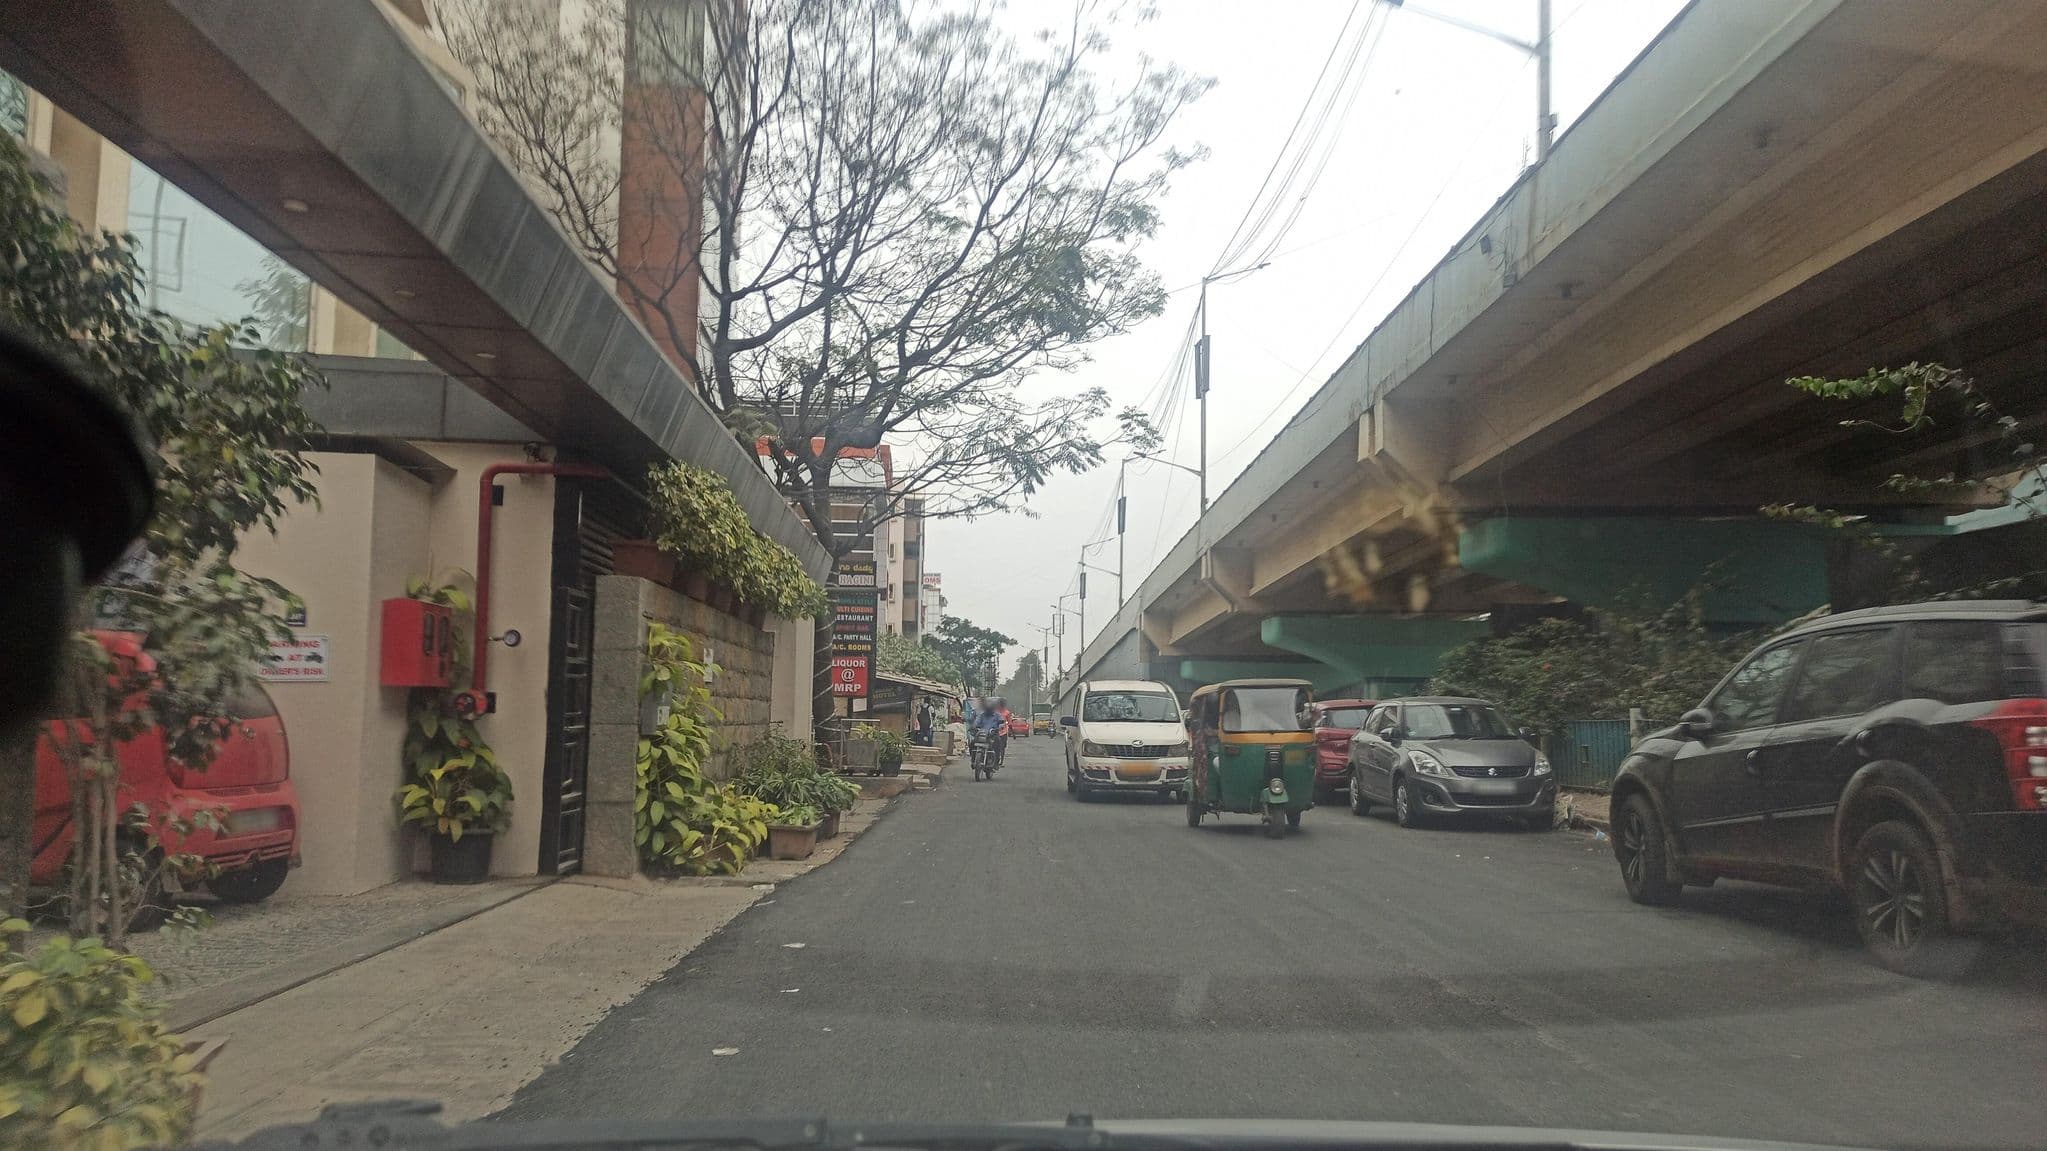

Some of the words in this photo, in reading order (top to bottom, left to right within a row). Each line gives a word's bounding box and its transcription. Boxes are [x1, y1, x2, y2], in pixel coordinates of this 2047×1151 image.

[831, 659, 866, 668] LIQUOR
[841, 668, 855, 682] @
[834, 683, 862, 692] MRP
